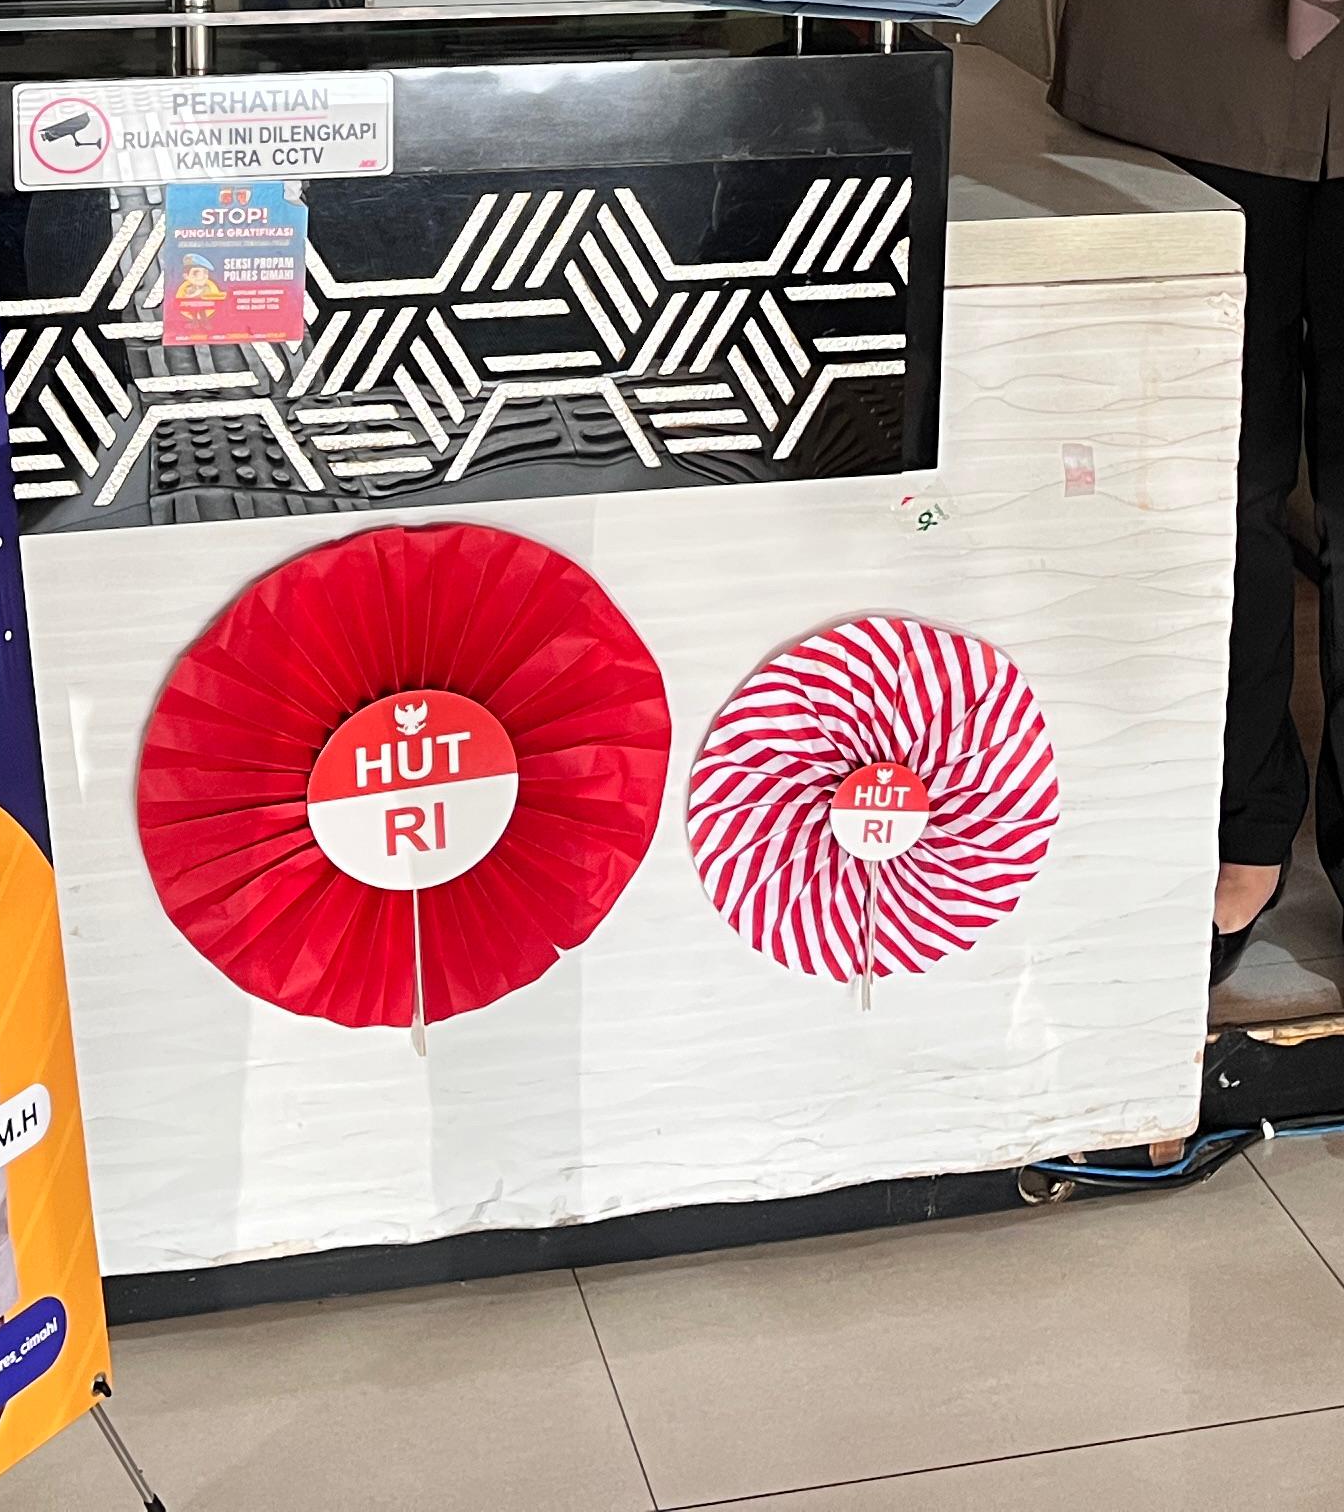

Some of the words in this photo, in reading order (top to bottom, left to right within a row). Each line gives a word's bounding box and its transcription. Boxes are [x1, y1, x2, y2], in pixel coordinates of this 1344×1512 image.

[171, 88, 330, 116] PERHATIAN
[123, 129, 222, 149] RUANGAN
[229, 125, 253, 144] INI
[259, 123, 377, 144] DILENGKAPI
[176, 150, 261, 170] KAMERA
[272, 146, 324, 166] CCTV
[201, 208, 268, 225] STOP!
[174, 228, 215, 238] PUNGLI
[227, 227, 294, 238] GRATIFIKASI
[224, 258, 251, 270] SEKSI
[355, 731, 471, 788] HUT
[855, 785, 911, 809] HUT
[384, 802, 446, 856] RI
[862, 818, 893, 844] RI
